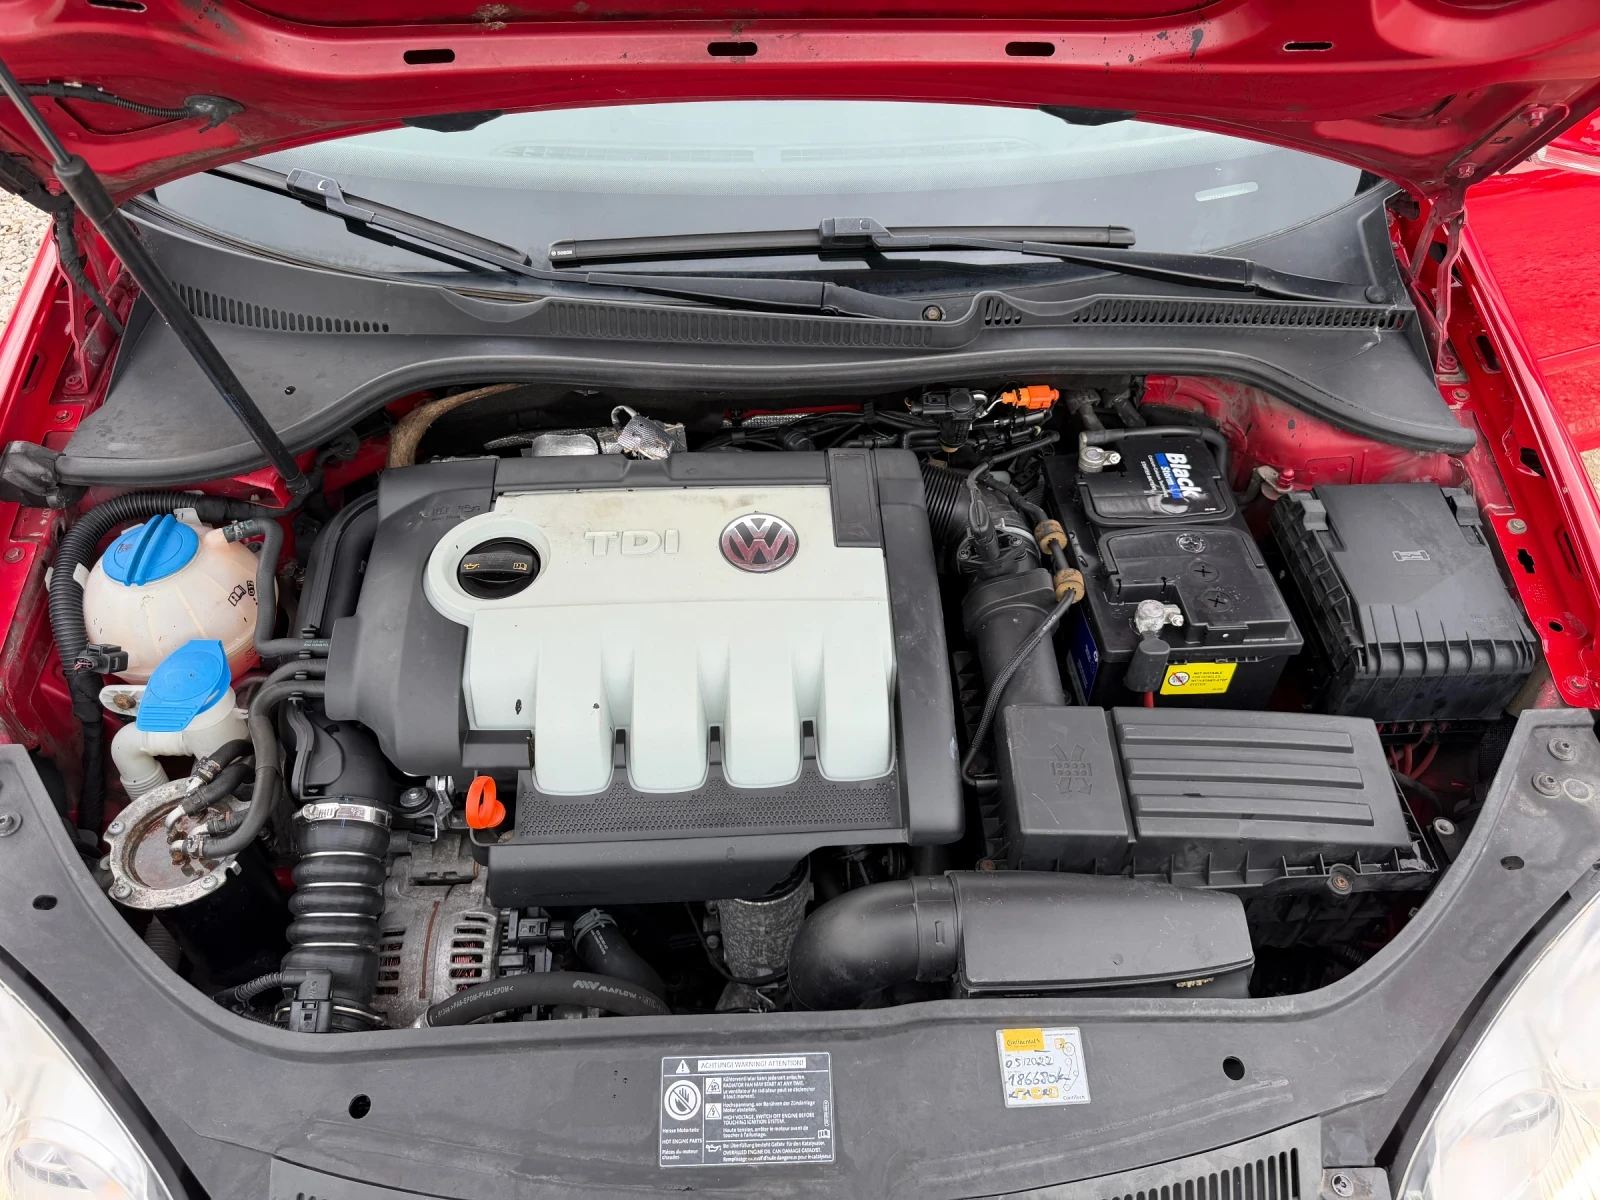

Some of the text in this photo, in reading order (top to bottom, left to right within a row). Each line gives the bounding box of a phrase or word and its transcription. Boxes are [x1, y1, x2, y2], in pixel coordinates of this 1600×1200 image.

[1161, 466, 1174, 485] Storm
[1165, 453, 1202, 498] Black
[584, 529, 680, 556] TDI
[700, 1061, 734, 1070] ACHTUNG!
